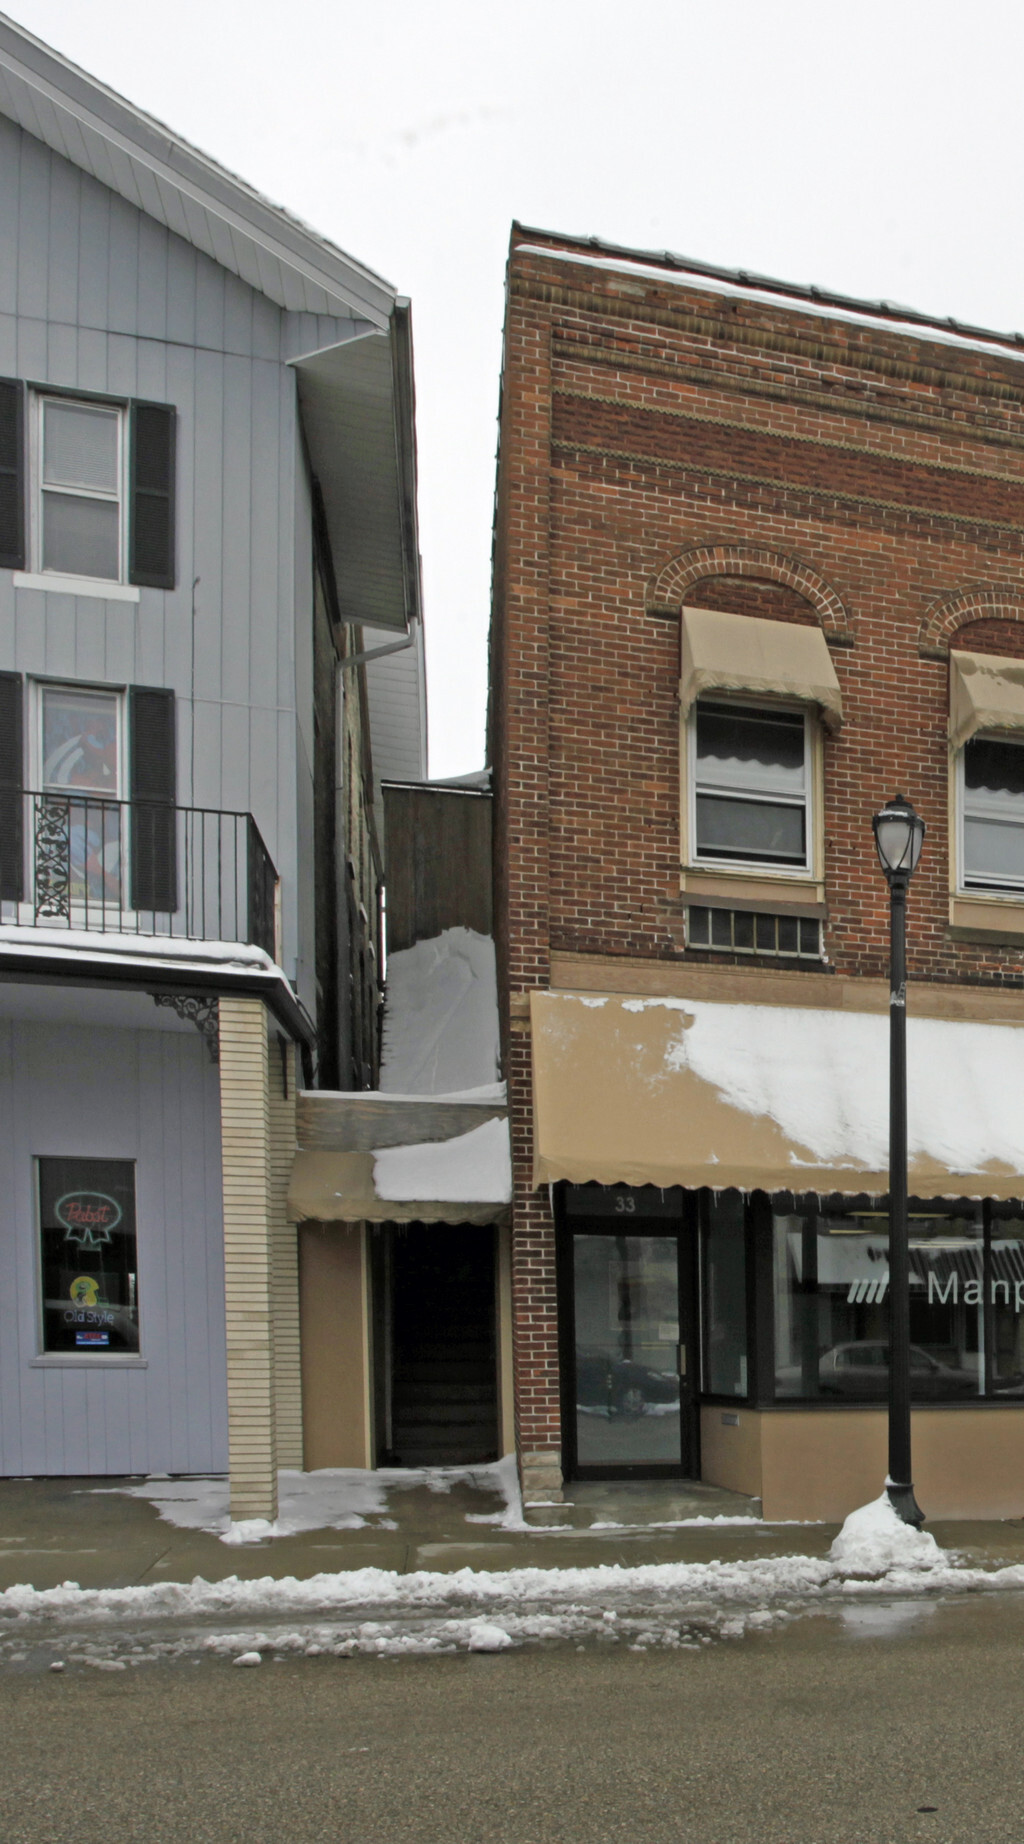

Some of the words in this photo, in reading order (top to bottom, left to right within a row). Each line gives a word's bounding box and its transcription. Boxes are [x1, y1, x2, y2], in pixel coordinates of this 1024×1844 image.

[65, 1202, 111, 1223] Pabst
[615, 1196, 636, 1213] 33
[64, 1310, 85, 1322] Old
[87, 1311, 114, 1326] Style
